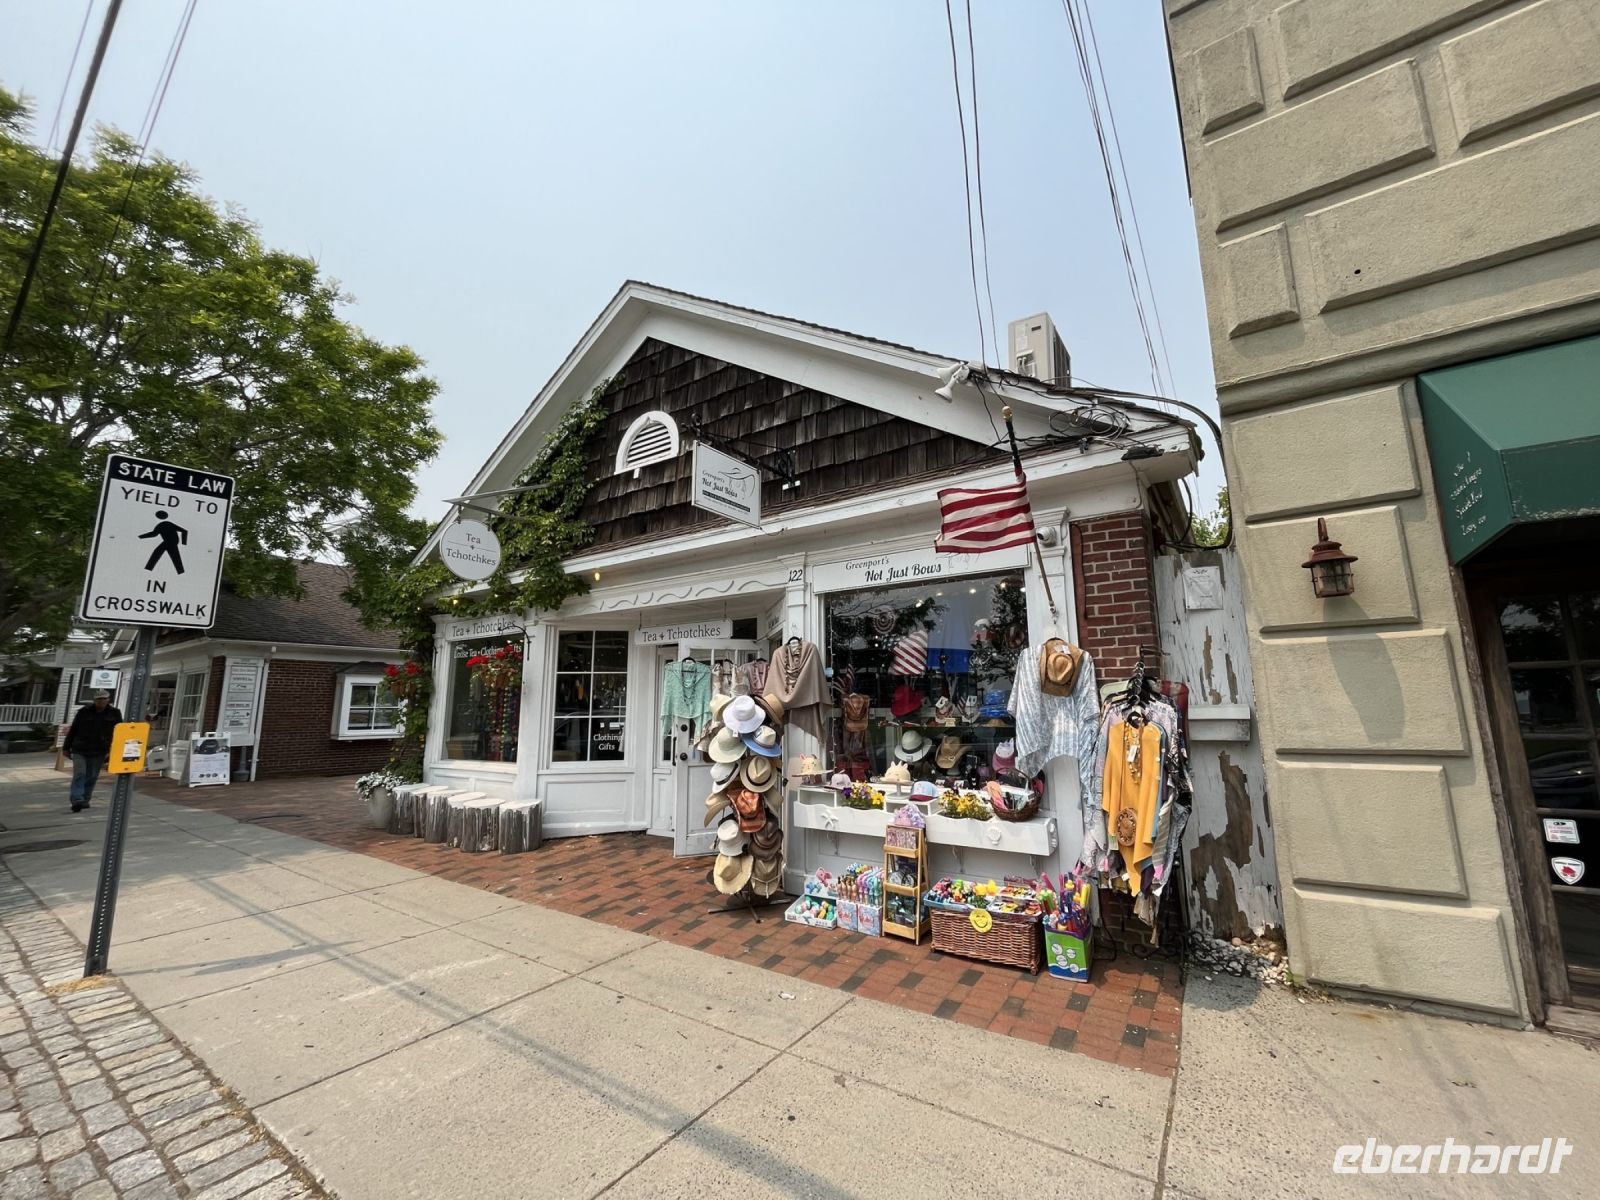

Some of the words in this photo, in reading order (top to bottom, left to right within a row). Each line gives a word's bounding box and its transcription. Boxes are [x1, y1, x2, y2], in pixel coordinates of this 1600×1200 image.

[118, 462, 176, 485] STATE
[188, 475, 226, 494] LAW
[121, 486, 180, 508] YIELD
[195, 499, 218, 515] TO
[466, 532, 481, 544] Tea
[446, 547, 497, 566] Tchotchkes
[845, 556, 890, 571] Greenport's
[789, 569, 803, 582] 122
[864, 570, 883, 583] Not
[886, 566, 909, 583] Just
[911, 563, 942, 577] Bows
[146, 579, 167, 594] IN
[94, 595, 207, 617] CROSSWALK
[452, 625, 464, 637] Tea
[642, 631, 657, 642] Tea
[667, 624, 721, 640] Tchotchkes
[598, 742, 615, 751] Gifts
